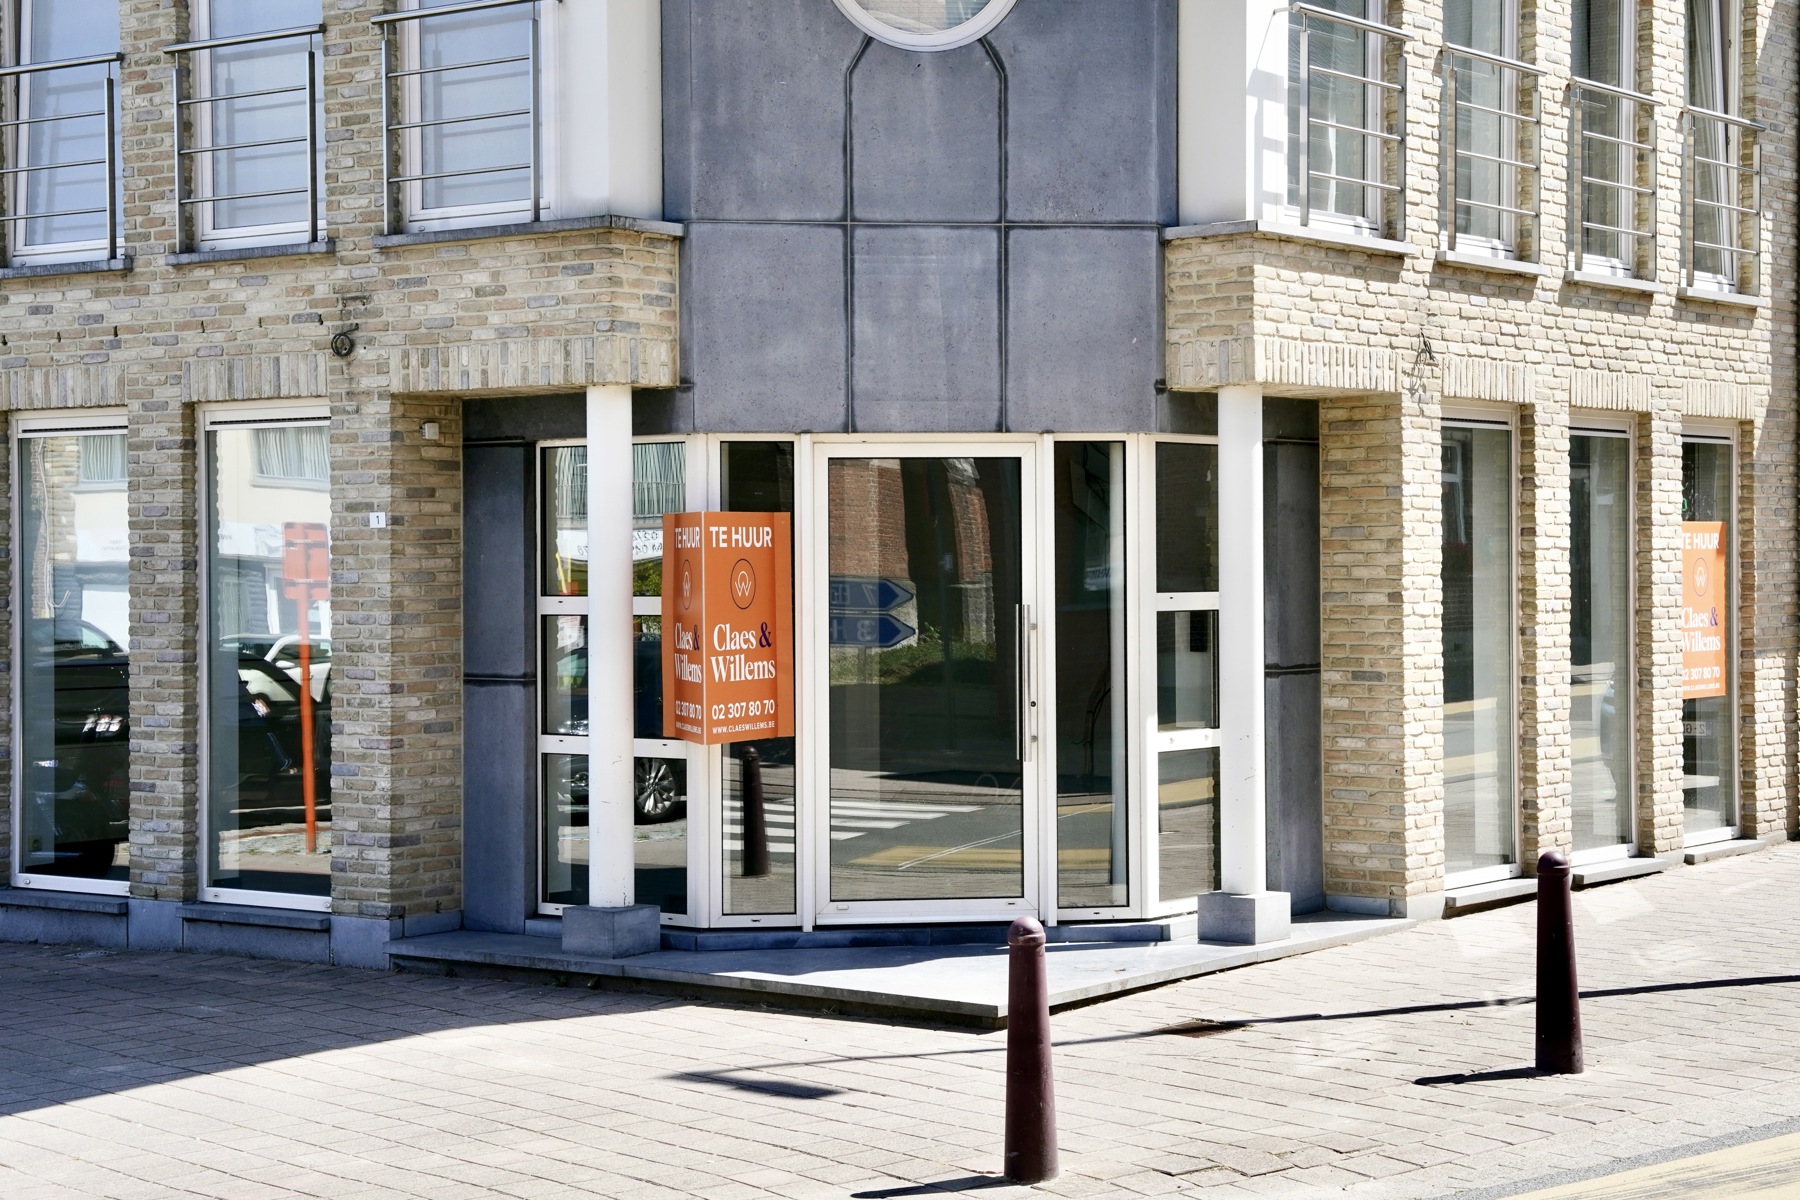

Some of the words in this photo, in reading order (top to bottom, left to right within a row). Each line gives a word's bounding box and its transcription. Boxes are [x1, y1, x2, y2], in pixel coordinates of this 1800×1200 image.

[675, 527, 682, 549] TE
[682, 526, 701, 549] HUUR
[709, 526, 728, 548] TE
[731, 526, 772, 548] HUUR
[1681, 532, 1692, 550] TE
[1693, 532, 1720, 550] HUUR
[1682, 607, 1709, 628] Claes
[1710, 606, 1718, 627] &
[675, 622, 693, 651] Claes
[693, 624, 700, 651] &
[713, 623, 757, 651] Claes
[759, 621, 772, 648] &
[1682, 631, 1721, 652] Willems
[674, 653, 702, 684] Willems
[710, 653, 776, 683] Willems
[1690, 667, 1703, 680] 307
[1703, 666, 1712, 679] 80
[1712, 665, 1720, 678] 70
[675, 700, 681, 715] 02
[681, 701, 689, 717] 307
[689, 703, 695, 718] 80
[695, 704, 702, 720] 70
[711, 704, 725, 720] 02
[727, 702, 746, 719] 307
[748, 700, 762, 717] 80
[763, 699, 775, 715] 70
[712, 720, 776, 734] WWW.CLAESWILLEMS.BE
